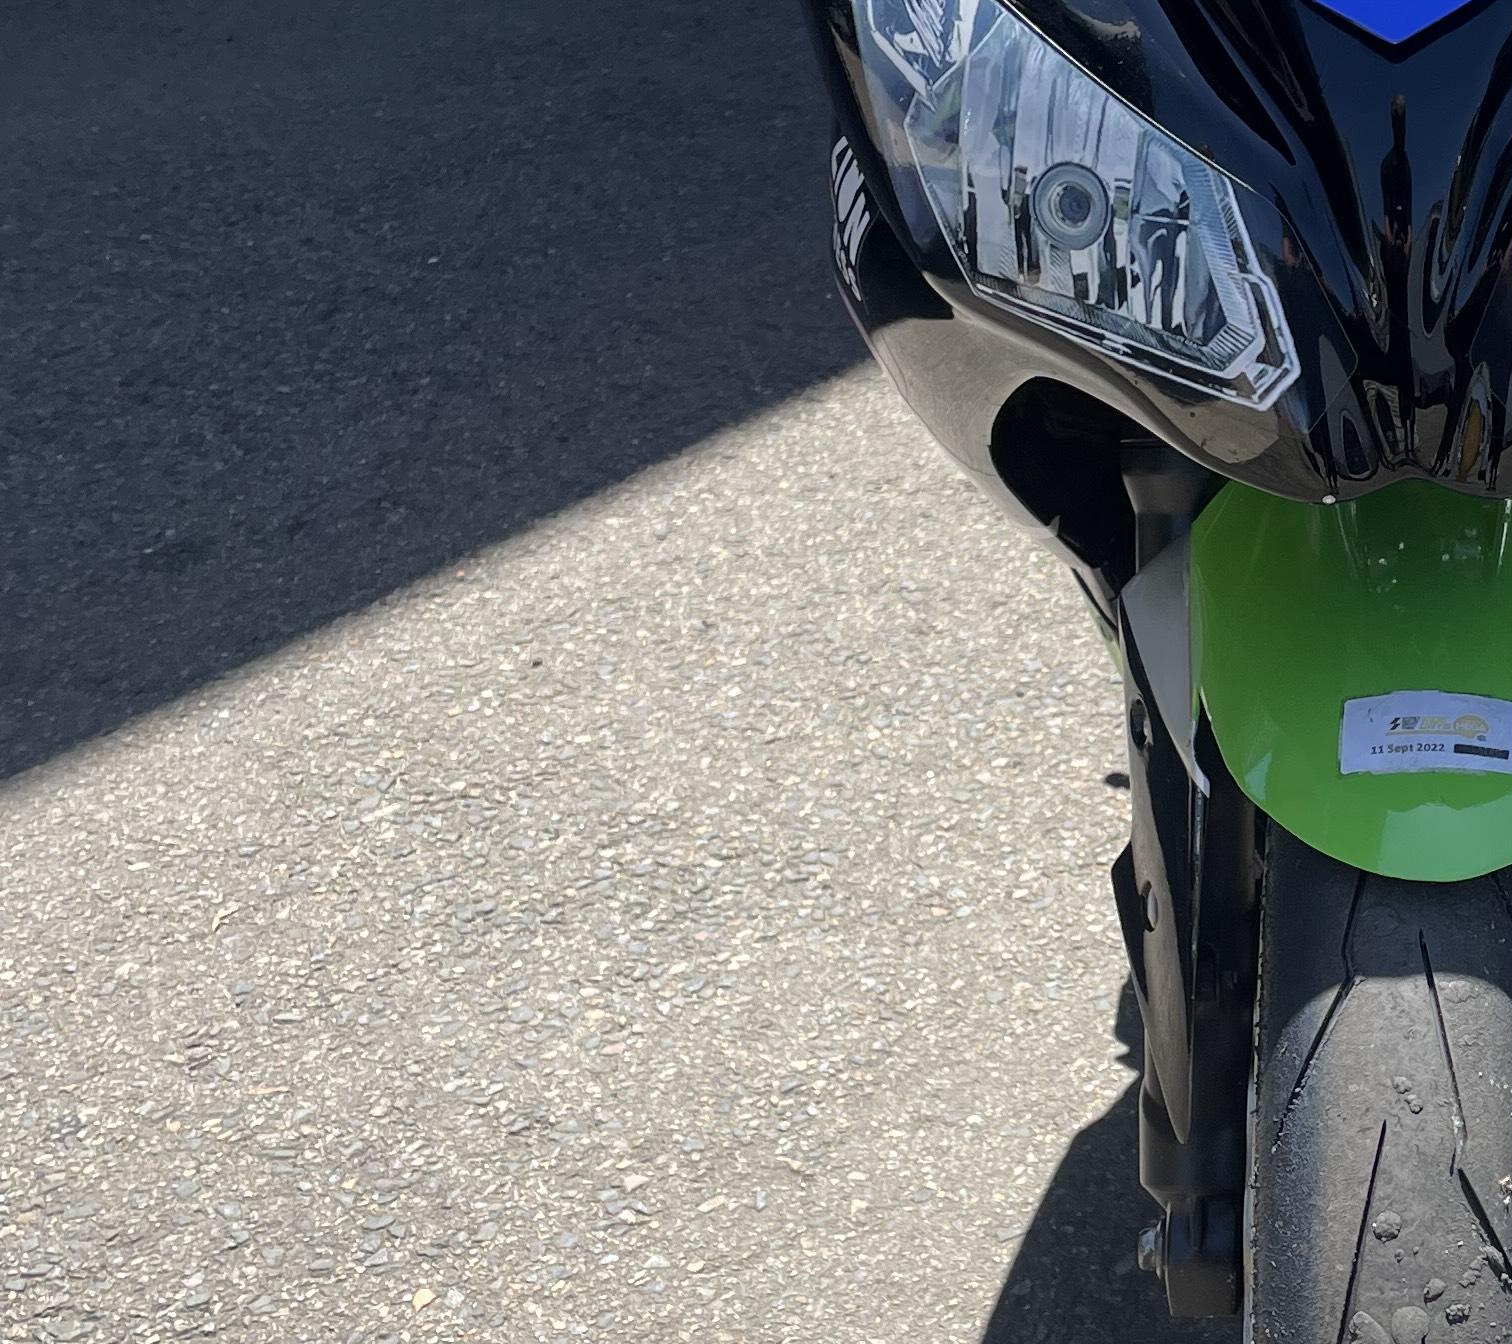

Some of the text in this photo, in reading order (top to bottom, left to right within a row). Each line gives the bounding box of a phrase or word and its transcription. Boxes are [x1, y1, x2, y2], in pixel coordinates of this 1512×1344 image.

[1370, 743, 1445, 755] 11 Sept 2022
